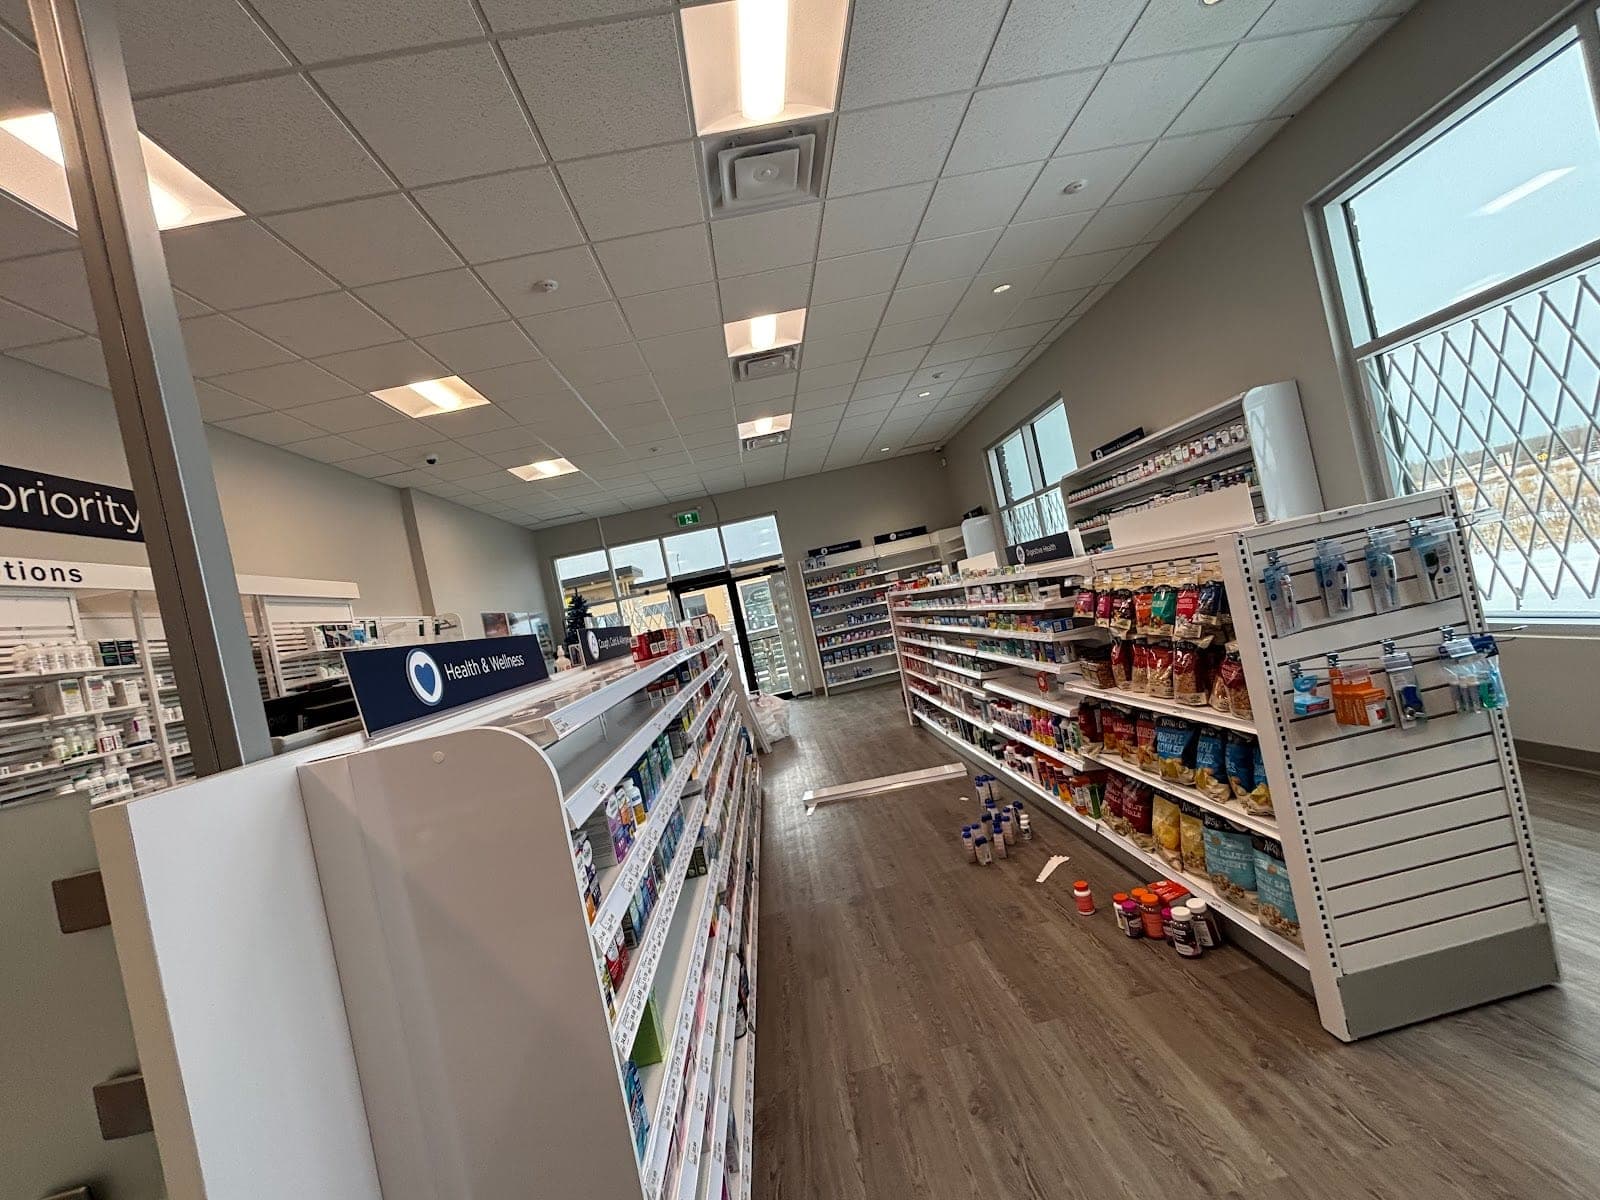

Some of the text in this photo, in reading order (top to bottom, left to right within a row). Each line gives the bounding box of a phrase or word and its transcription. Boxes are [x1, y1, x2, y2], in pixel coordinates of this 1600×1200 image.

[3, 560, 83, 583] tions
[444, 653, 526, 680] Health & Wellness
[1157, 732, 1185, 745] RIPPLE
